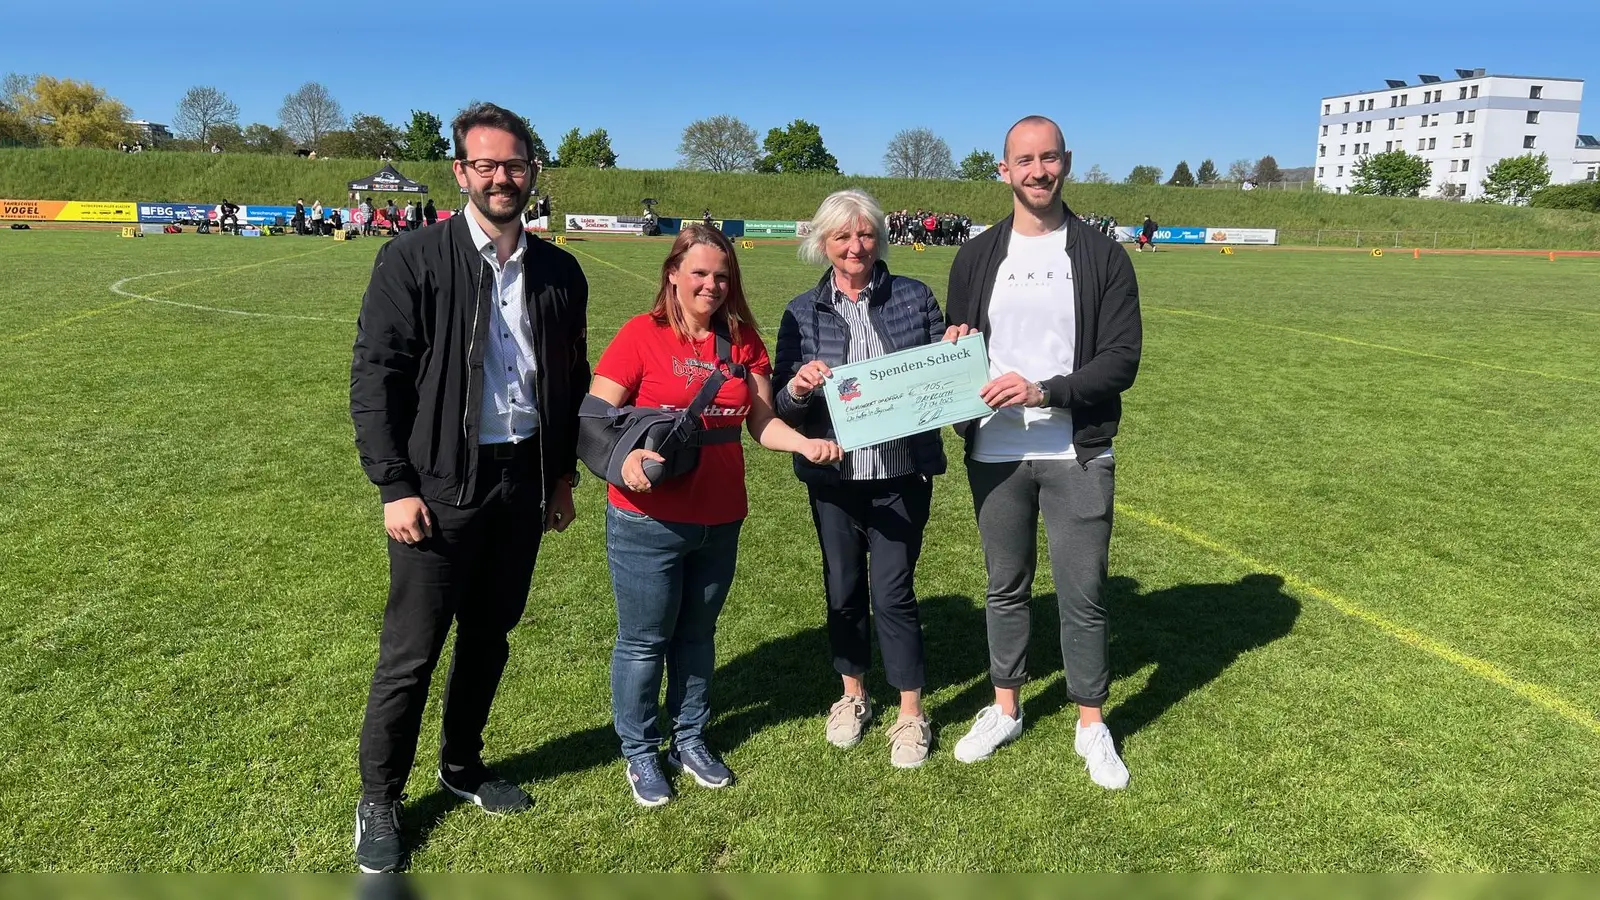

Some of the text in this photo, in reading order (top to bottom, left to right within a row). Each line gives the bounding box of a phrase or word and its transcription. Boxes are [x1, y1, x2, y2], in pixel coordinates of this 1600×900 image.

[5, 206, 39, 215] VOGEL
[151, 207, 173, 215] FBG
[124, 228, 134, 236] 30
[335, 231, 345, 239] 40
[1152, 230, 1171, 239] AKO
[556, 237, 566, 245] 50
[870, 349, 971, 380] Spenden-Scheck
